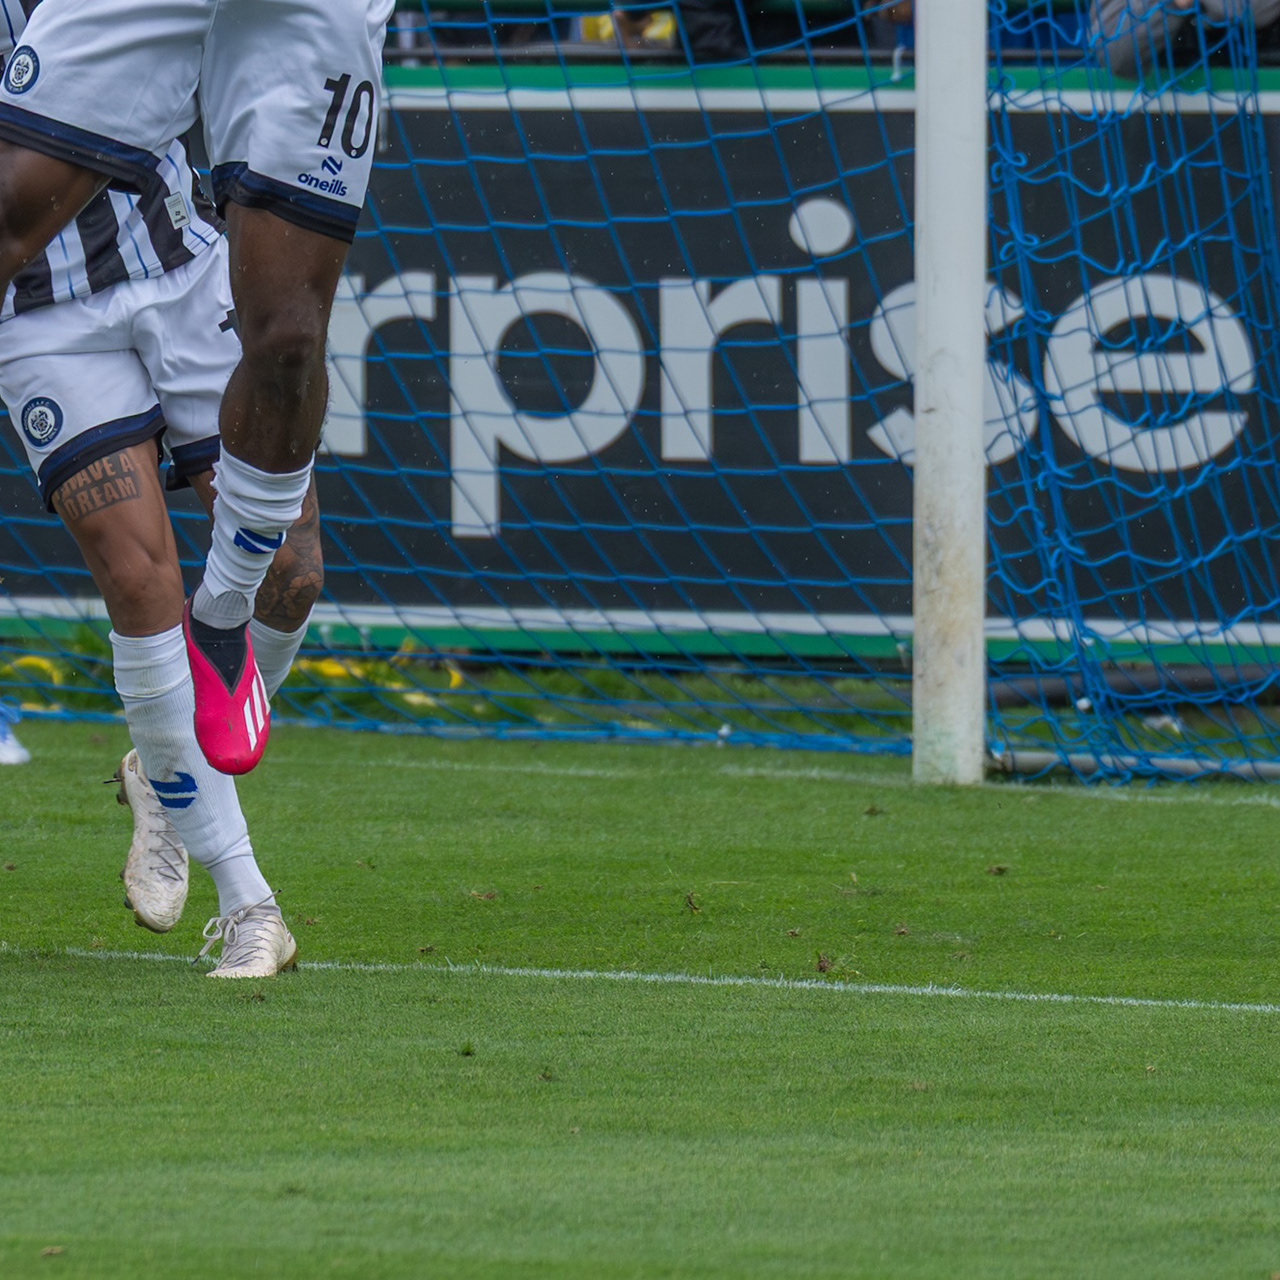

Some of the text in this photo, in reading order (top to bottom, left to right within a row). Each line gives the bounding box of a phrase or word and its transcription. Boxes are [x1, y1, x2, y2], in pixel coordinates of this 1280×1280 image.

[316, 72, 375, 159] 10
[320, 199, 1255, 539] rprise
[61, 476, 140, 521] DREAM
